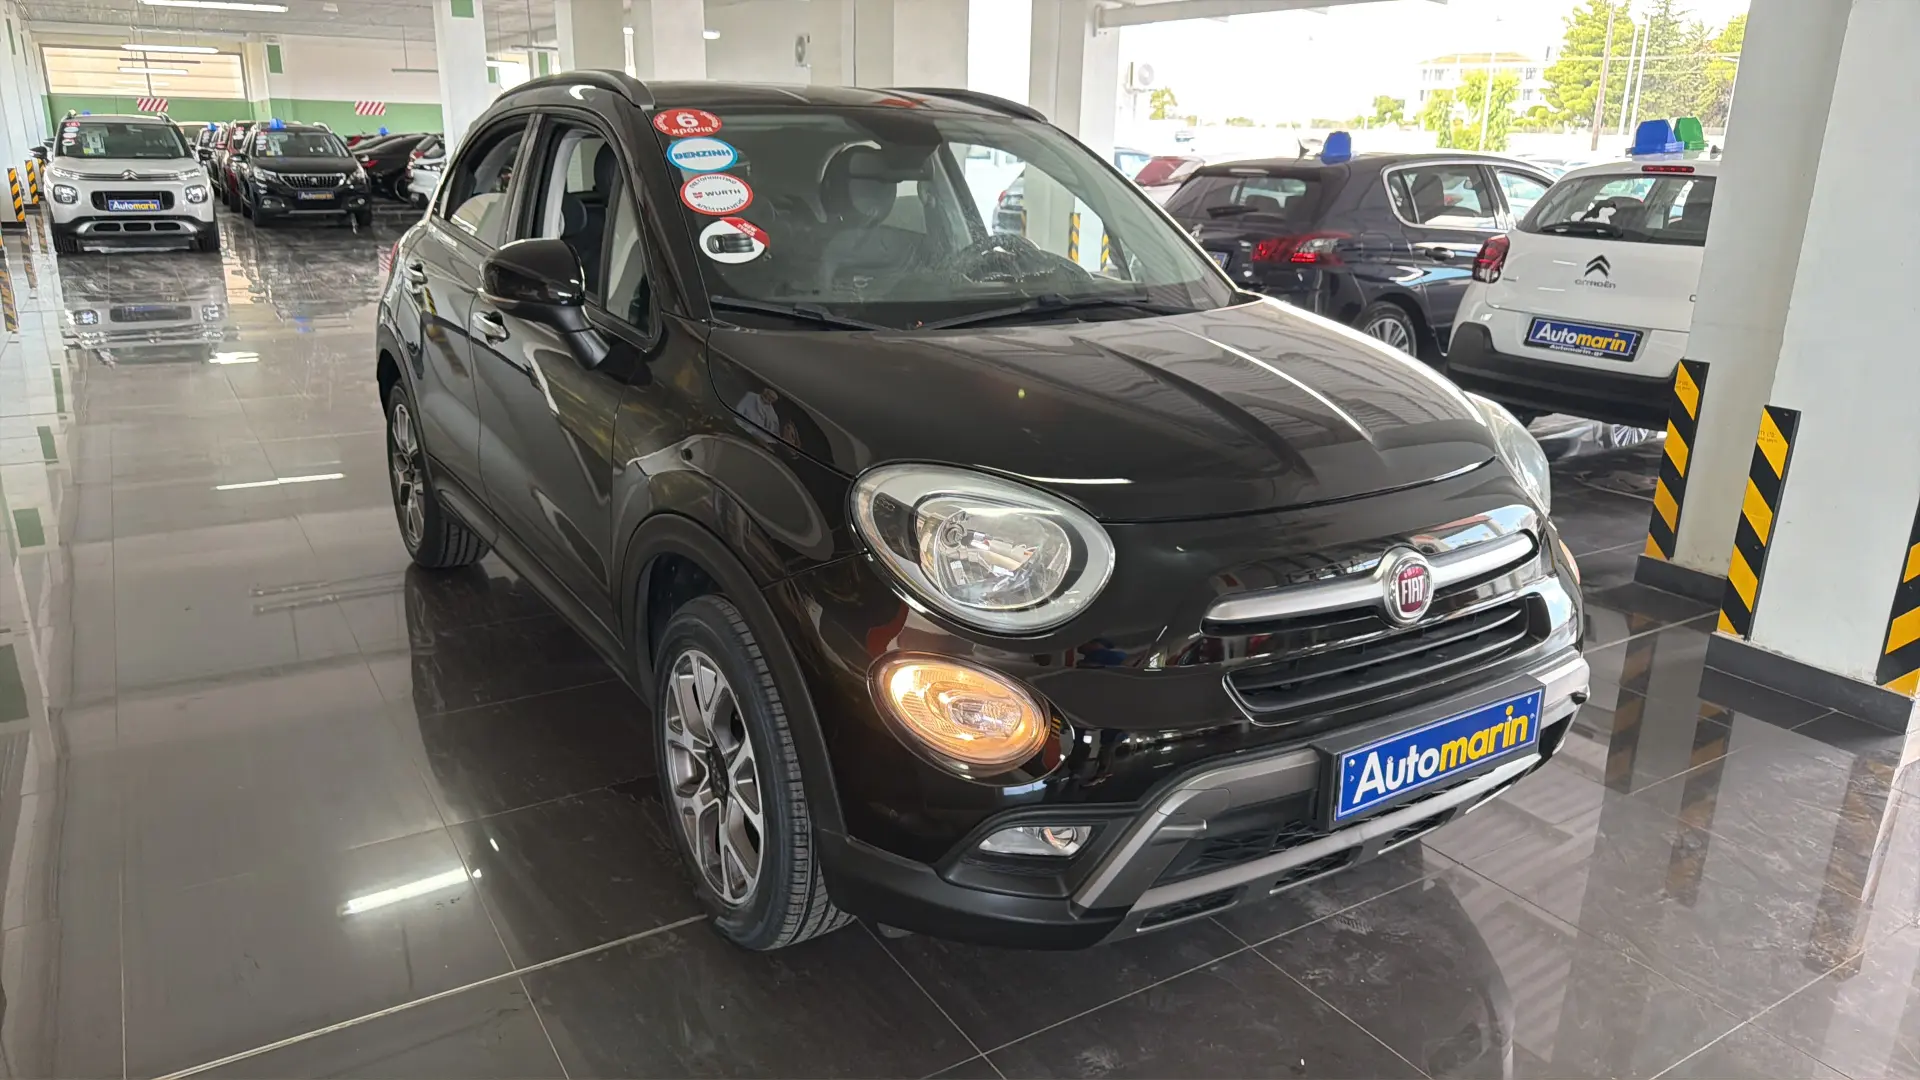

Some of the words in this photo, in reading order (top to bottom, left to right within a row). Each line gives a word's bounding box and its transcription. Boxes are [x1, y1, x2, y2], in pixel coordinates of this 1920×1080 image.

[676, 113, 698, 128] 6
[673, 149, 731, 159] ΒΕΝΖΙΝΗ
[112, 200, 157, 210] Automarin
[1535, 323, 1627, 352] Automarin
[1401, 575, 1424, 605] FIAT
[1352, 705, 1528, 804] Automarin
